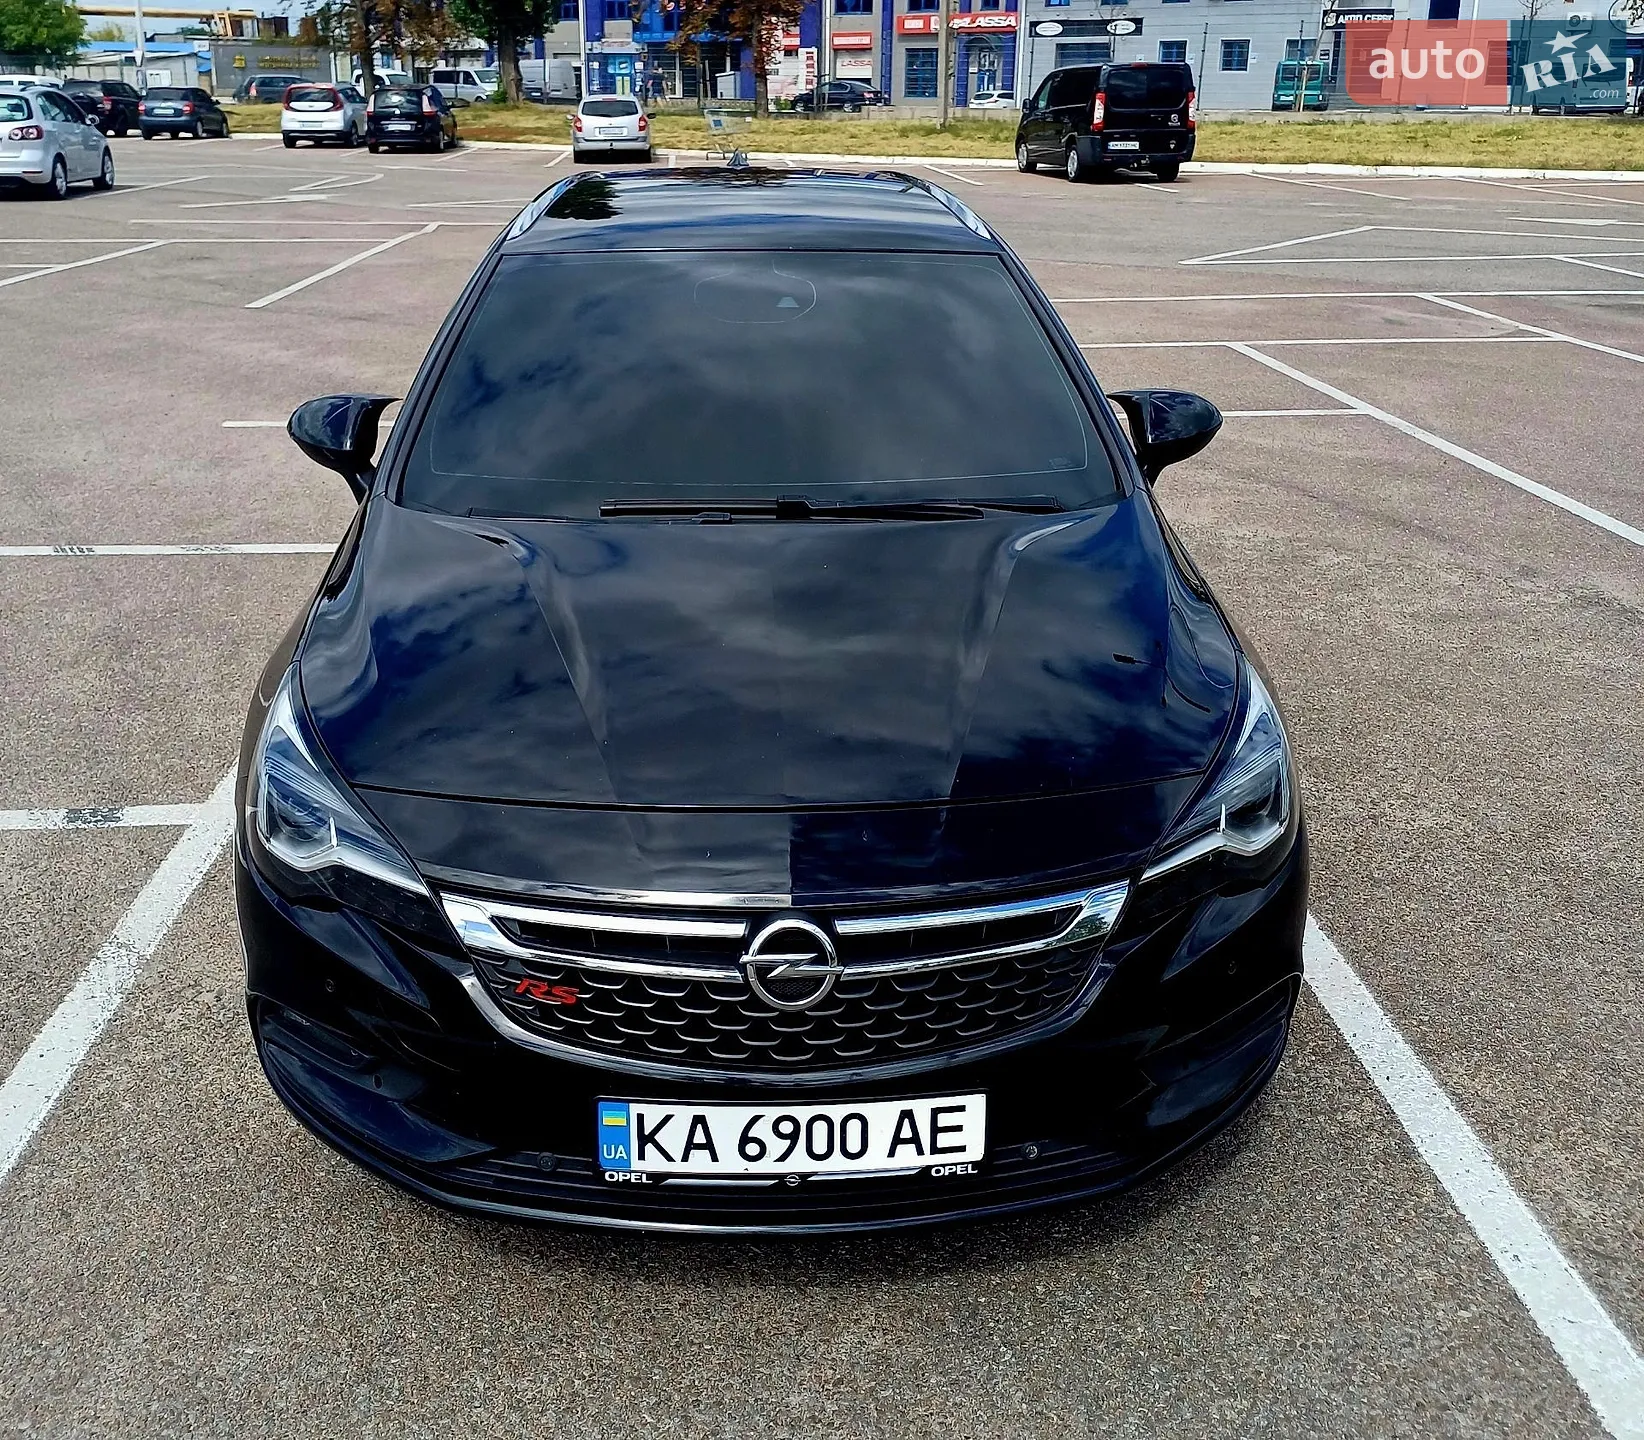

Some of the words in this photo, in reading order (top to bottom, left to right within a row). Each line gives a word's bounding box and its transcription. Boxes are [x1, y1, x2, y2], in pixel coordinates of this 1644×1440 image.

[961, 15, 1018, 29] LASSA
[515, 978, 579, 1004] RS
[636, 1112, 720, 1163] KA
[738, 1112, 869, 1163] 6900
[886, 1104, 967, 1159] AE
[603, 1144, 629, 1161] UA
[604, 1171, 653, 1184] OPEL
[931, 1164, 979, 1178] OPEL
